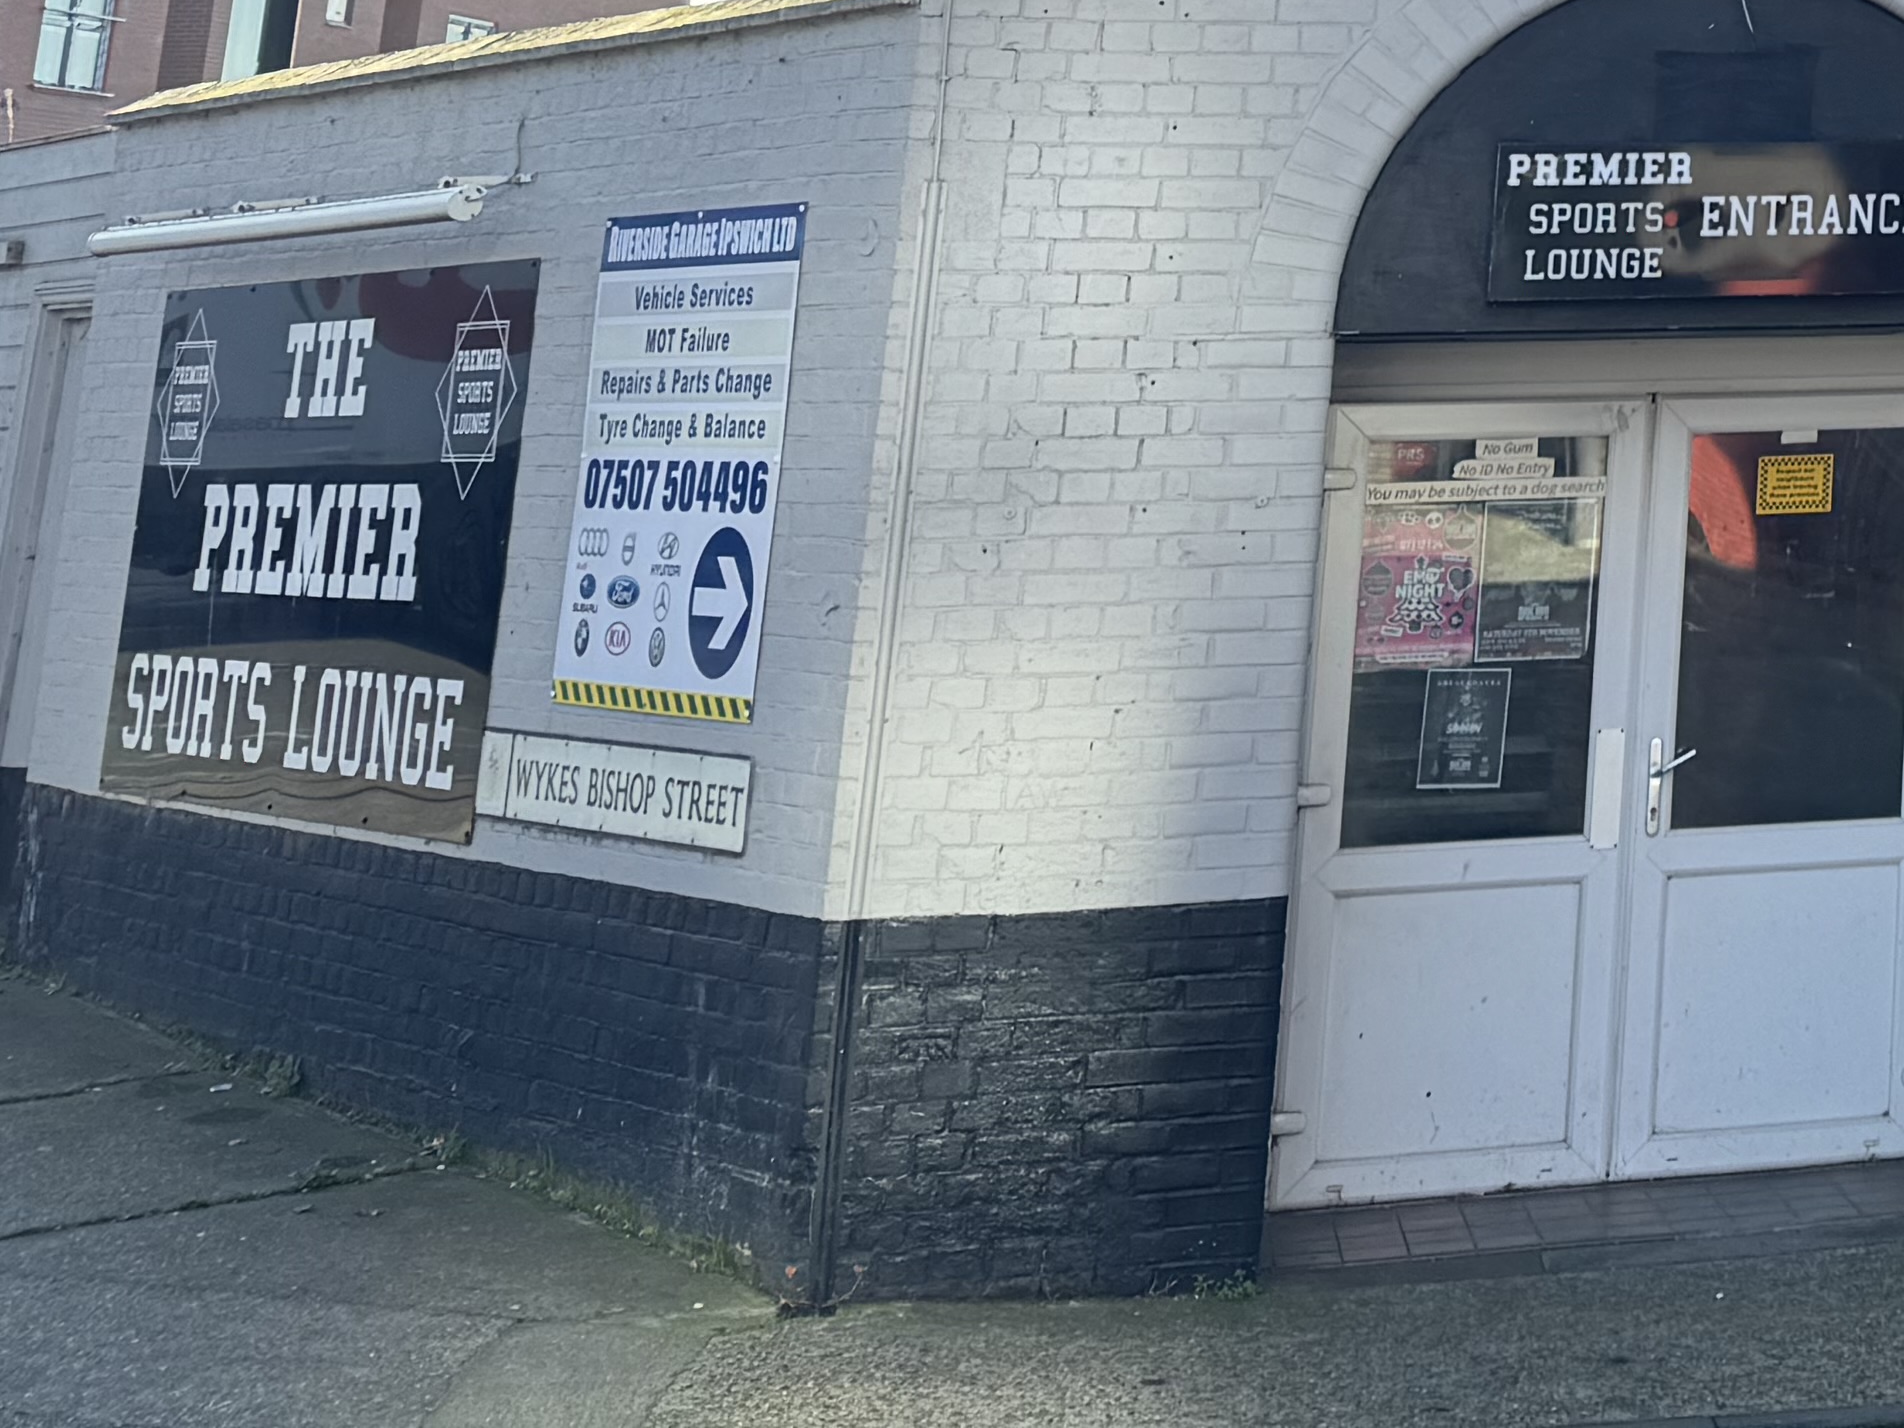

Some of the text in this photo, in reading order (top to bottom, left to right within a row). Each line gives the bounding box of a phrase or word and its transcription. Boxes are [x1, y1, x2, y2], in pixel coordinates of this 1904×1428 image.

[1506, 152, 1693, 186] PREMIER
[1528, 201, 1665, 234] SPORTS
[607, 216, 797, 262] RIVERSIDE GARAGE IPSWICH LTD
[1523, 247, 1663, 281] LOUNGE
[634, 281, 754, 310] Vehicle Services
[645, 326, 730, 353] MOT Failure
[284, 317, 375, 418] THE
[455, 348, 502, 372] PREMIER
[173, 365, 209, 385] PREMIER
[601, 367, 772, 401] Repairs & Parts Change
[173, 393, 202, 414] SPORTS
[456, 381, 494, 404] SPORTS
[169, 421, 200, 441] LOUNGE
[452, 413, 493, 435] LOUNGE
[599, 413, 766, 445] Tyre Change & Balance
[1397, 448, 1425, 460] PRS
[1483, 443, 1534, 455] No Gum
[1459, 461, 1551, 477] No ID No Entry
[584, 458, 769, 514] 07507 504496
[1367, 480, 1606, 503] You may be subject to a dog search
[192, 483, 422, 601] PREMIER
[1396, 583, 1446, 598] NIGHT
[608, 629, 627, 648] KIA
[121, 652, 464, 790] SPORTS LOUNGE
[517, 758, 744, 827] WYKES BISHOP STREET
